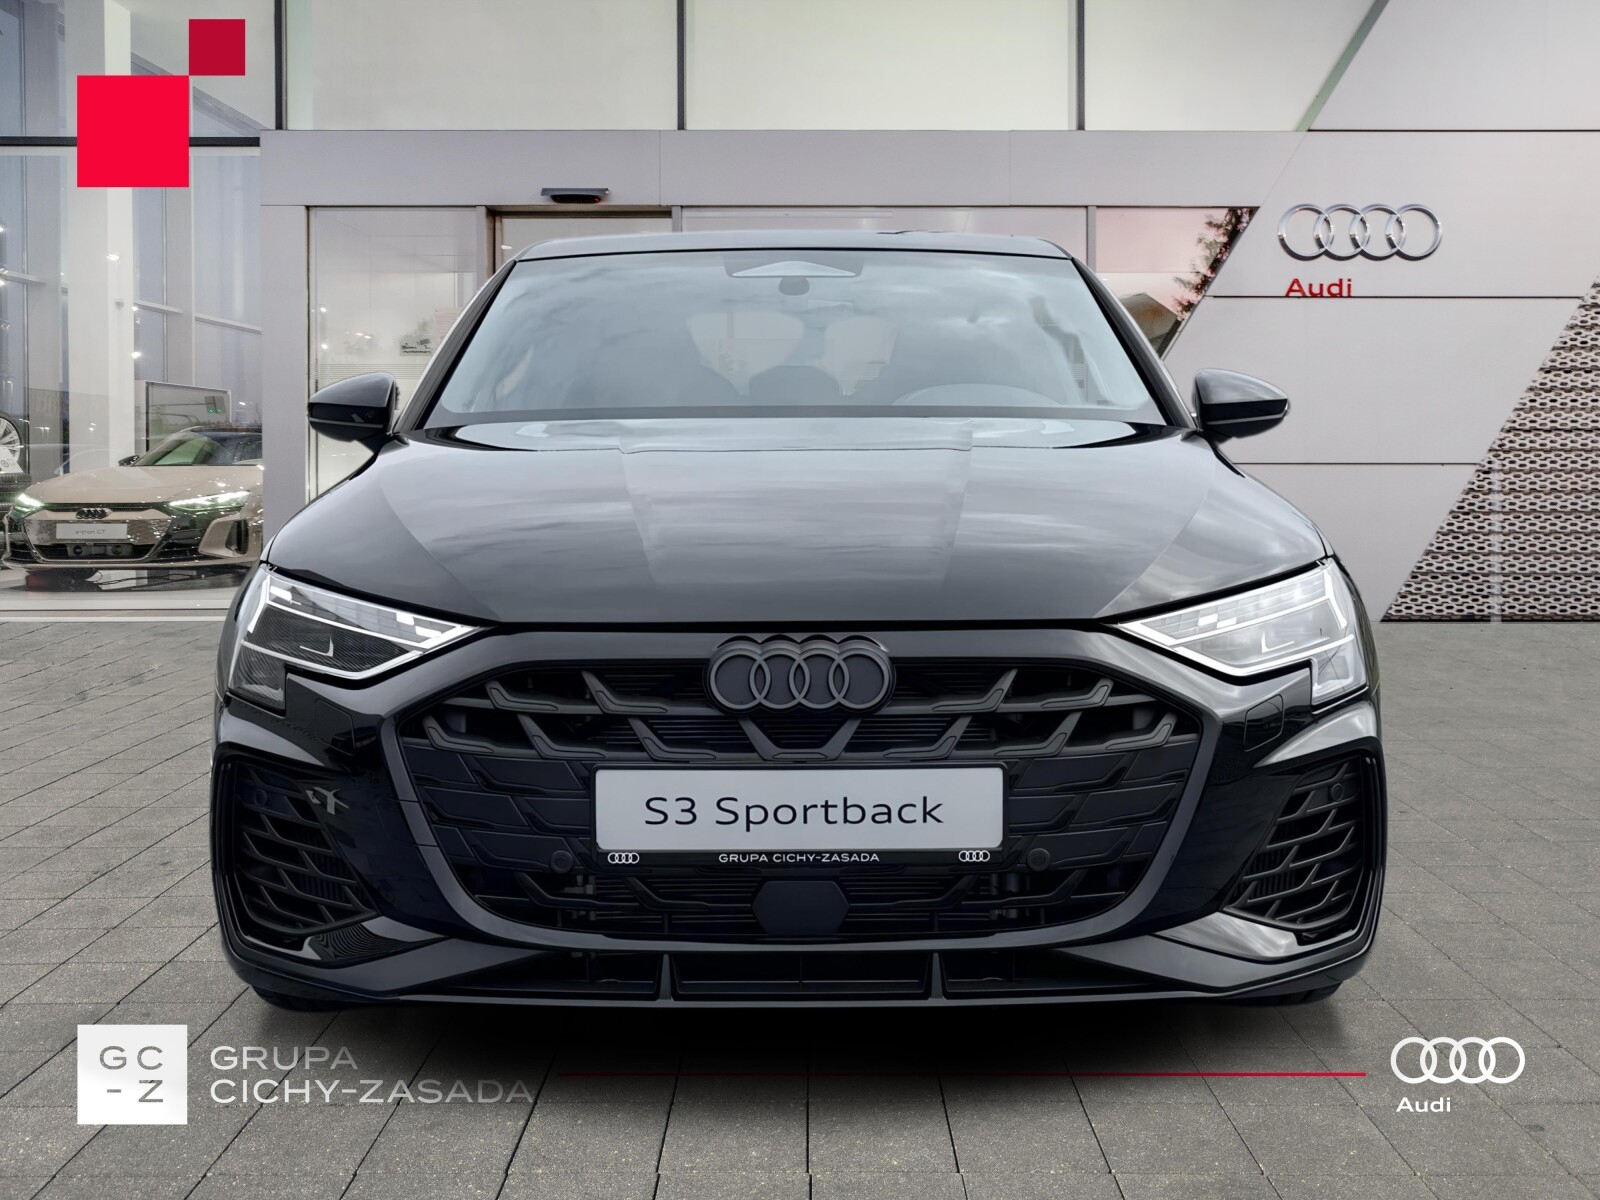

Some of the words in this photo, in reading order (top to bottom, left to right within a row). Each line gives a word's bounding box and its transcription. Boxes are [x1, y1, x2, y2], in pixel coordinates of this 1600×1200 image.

[1285, 278, 1352, 297] Audi
[644, 796, 698, 826] S3
[715, 796, 944, 832] Sportback
[718, 853, 769, 863] GRUPA
[772, 853, 880, 862] CICHY-ZASADA
